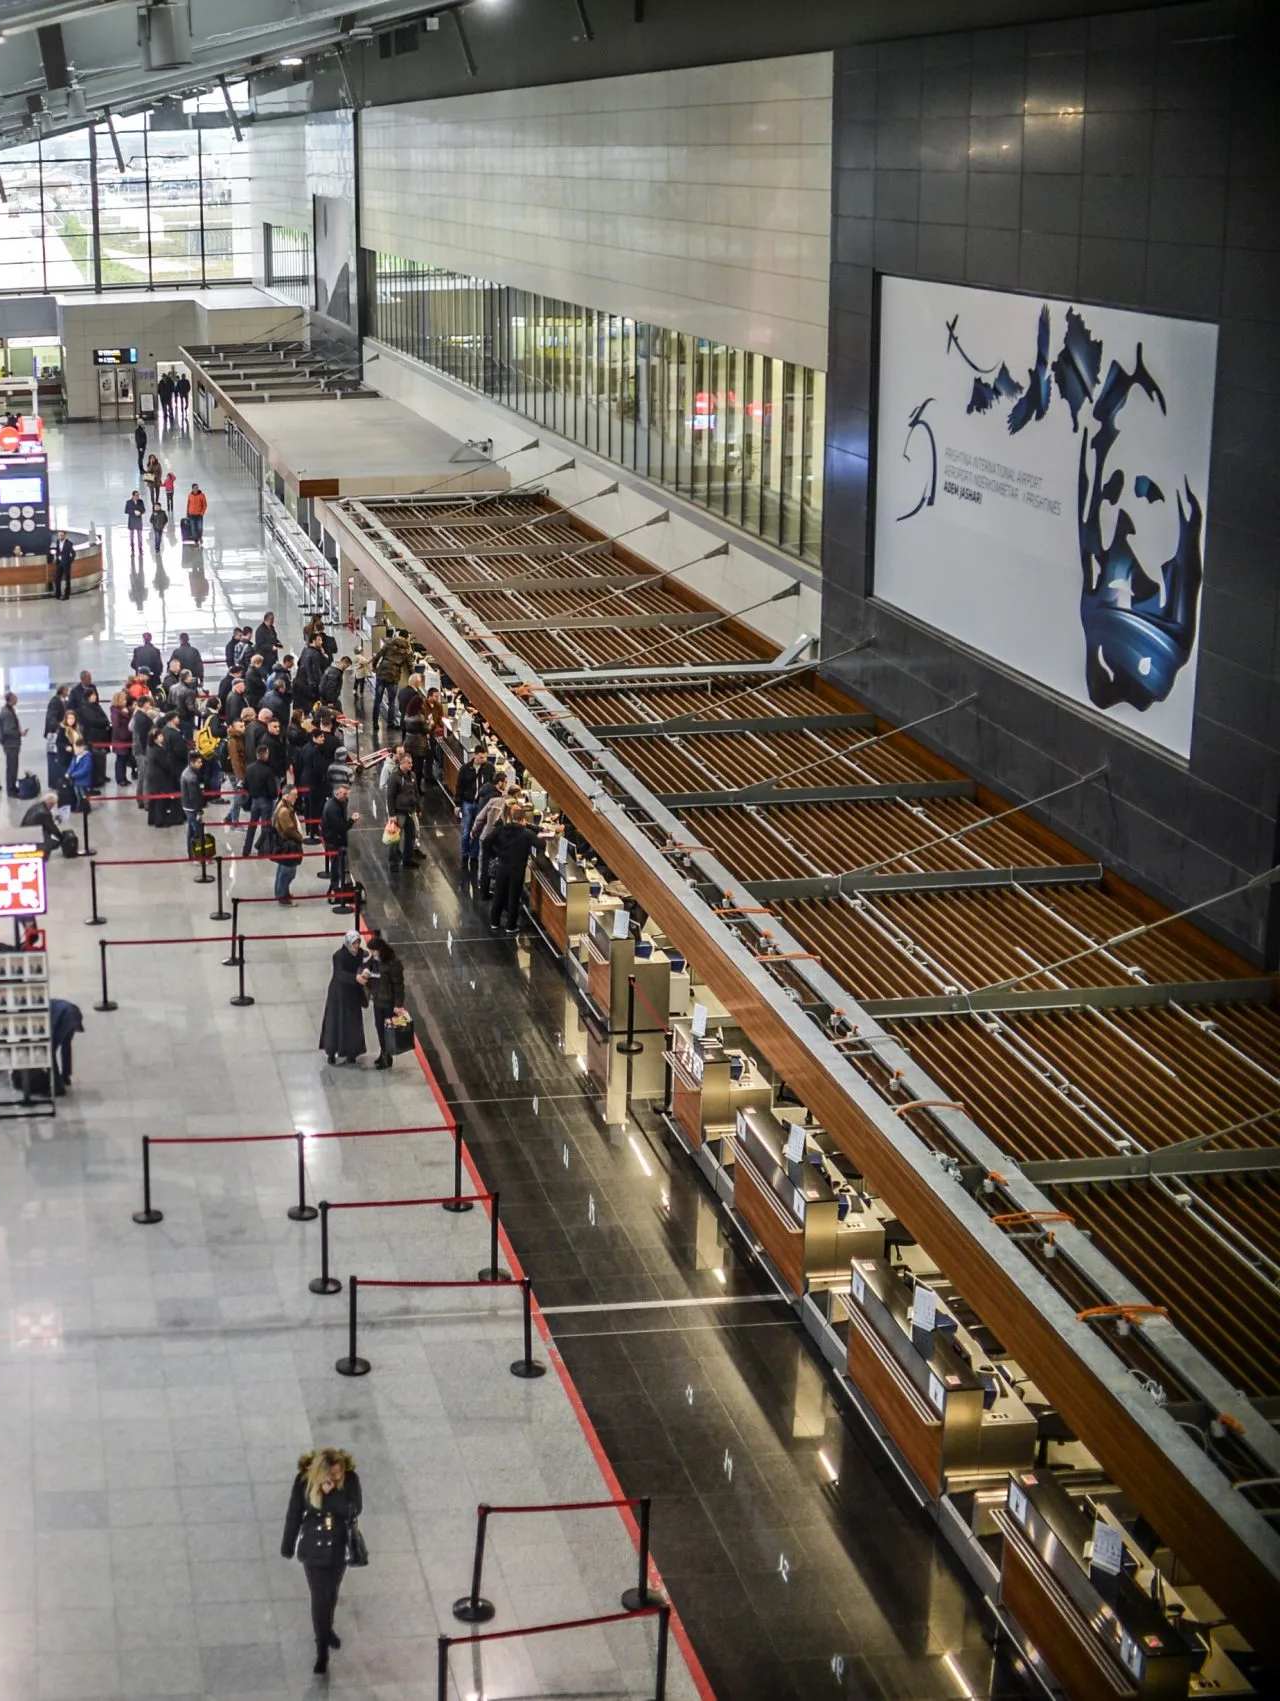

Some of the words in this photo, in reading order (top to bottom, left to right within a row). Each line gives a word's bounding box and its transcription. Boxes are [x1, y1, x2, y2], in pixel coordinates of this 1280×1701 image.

[1016, 470, 1043, 490] AIRPORT
[943, 480, 959, 496] ADEM
[959, 486, 983, 505] JASHARI
